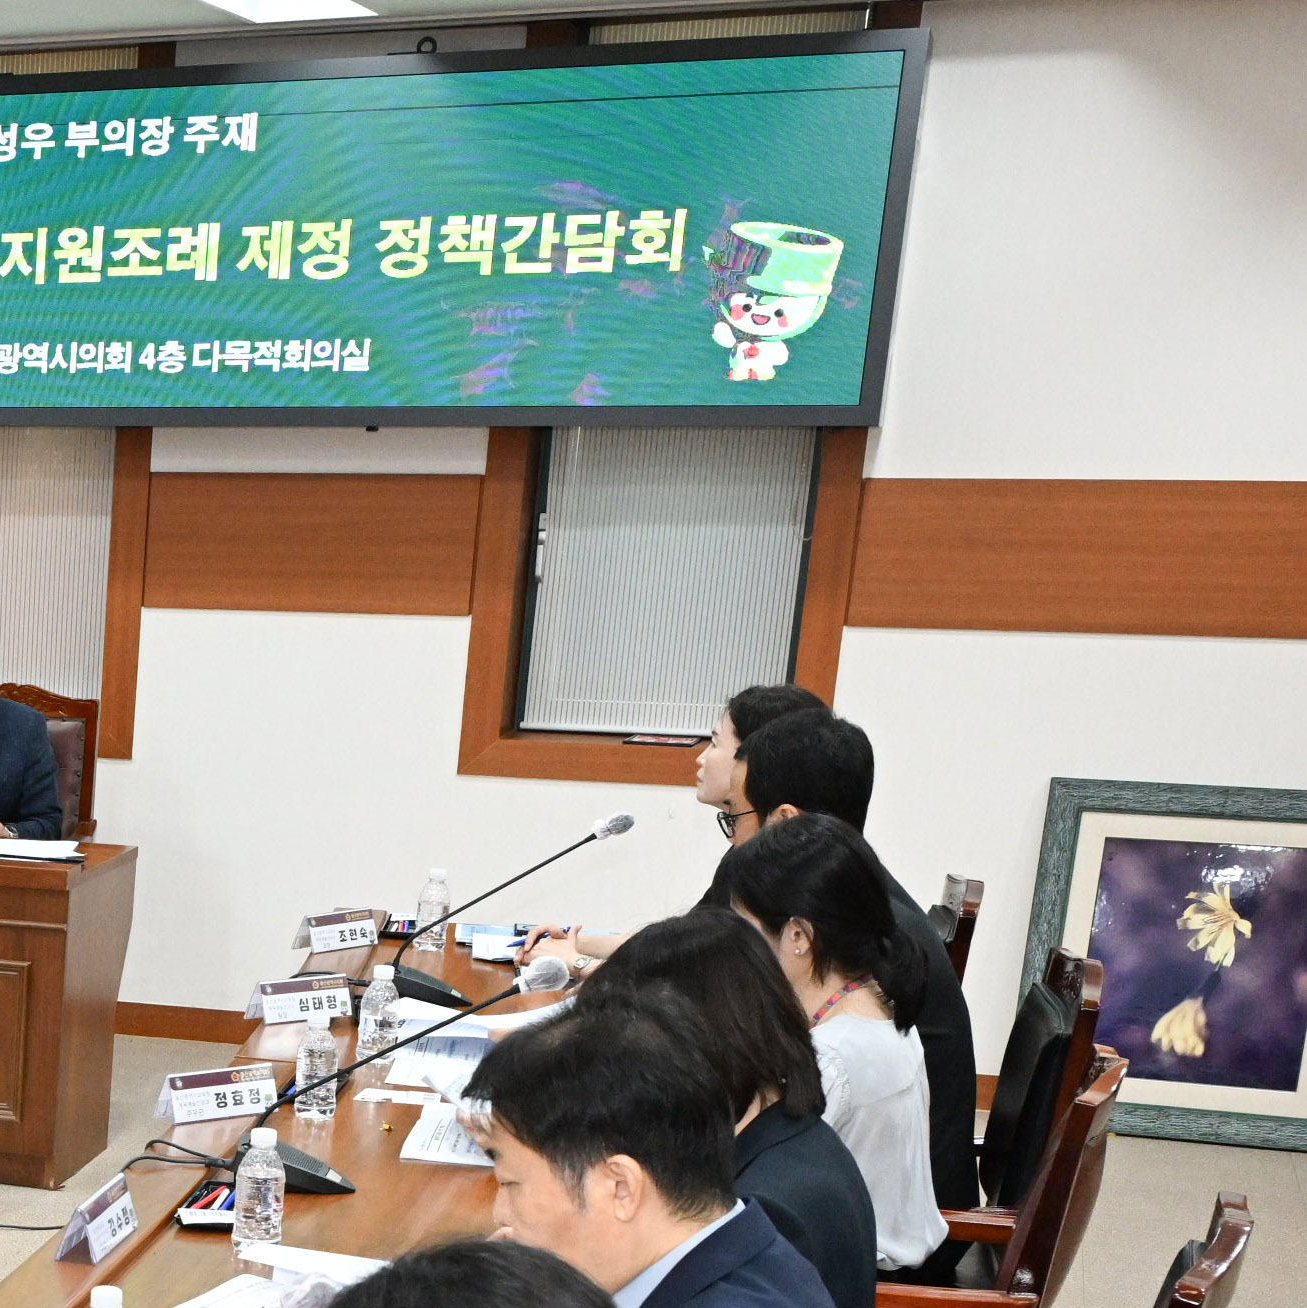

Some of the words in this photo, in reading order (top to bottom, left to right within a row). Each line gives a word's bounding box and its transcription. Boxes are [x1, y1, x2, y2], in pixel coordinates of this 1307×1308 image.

[64, 116, 175, 158] 부의장
[183, 112, 259, 154] 주재
[236, 218, 353, 280] 제정
[375, 208, 688, 279] 정책간담회
[138, 340, 187, 374] 4층
[192, 338, 372, 373] 다목적회의실
[299, 995, 337, 1012] 심태형
[214, 1087, 261, 1109] 정효정
